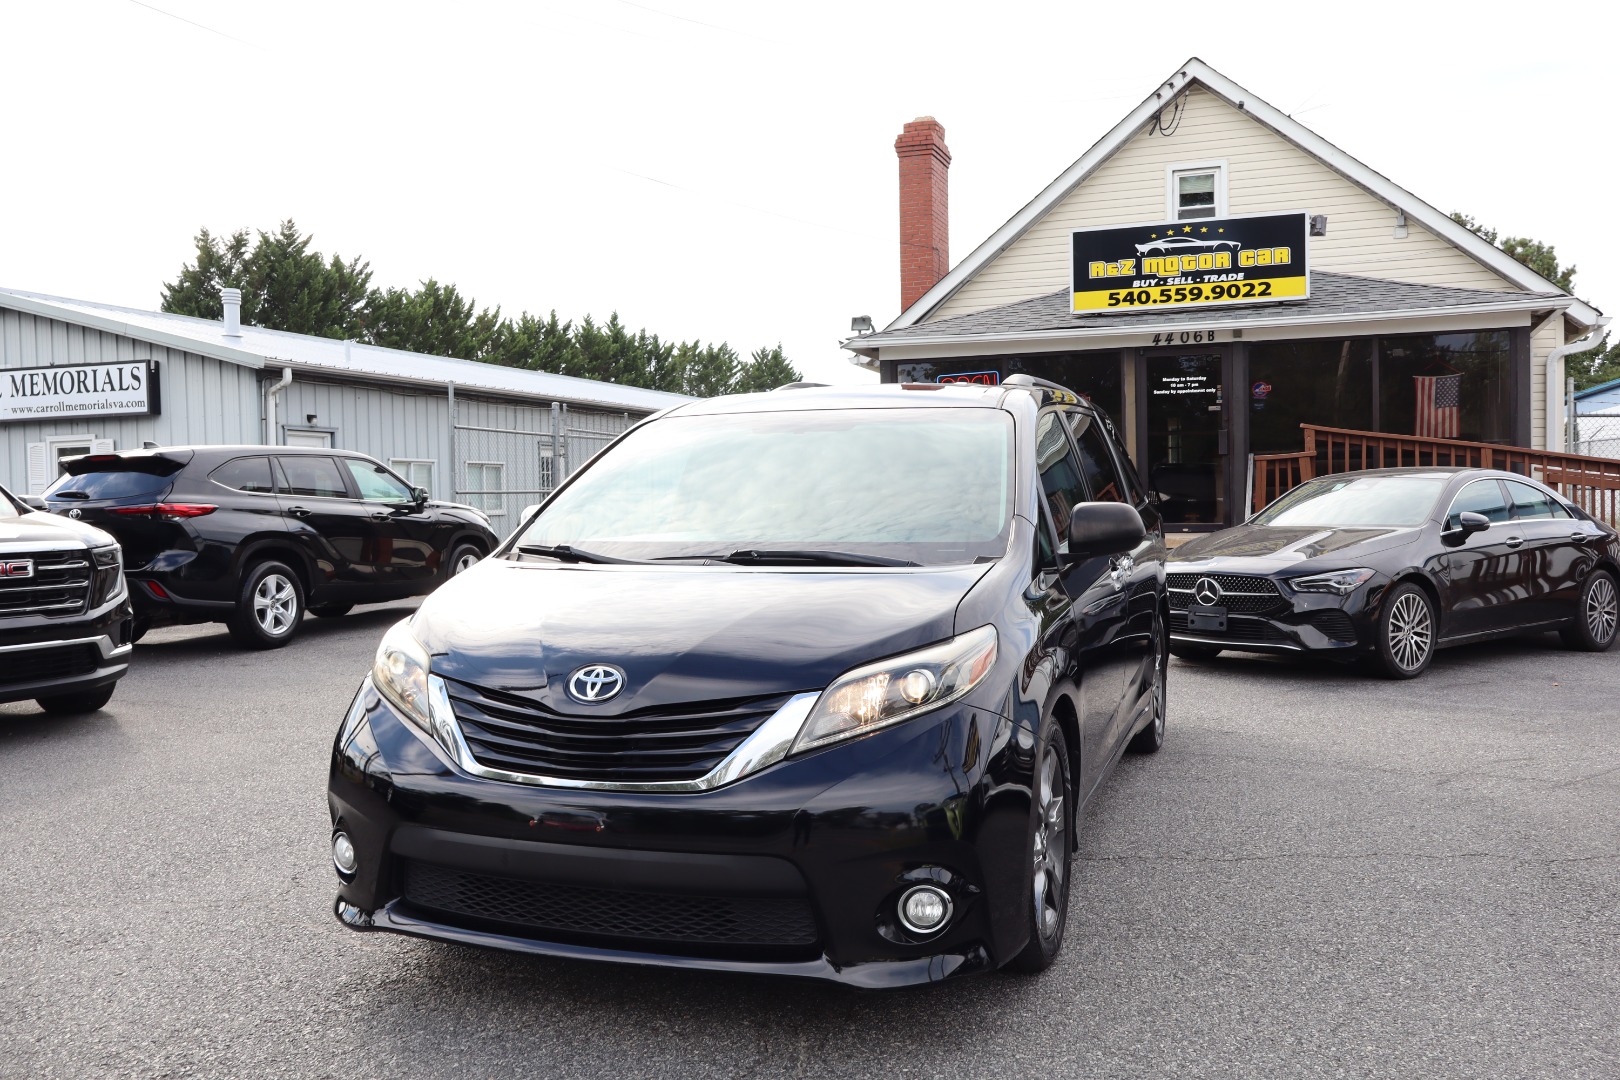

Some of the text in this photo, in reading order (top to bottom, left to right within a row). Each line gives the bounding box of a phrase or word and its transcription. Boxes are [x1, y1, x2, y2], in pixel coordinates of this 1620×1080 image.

[1132, 272, 1245, 288] BUY SELL TRADE
[1107, 281, 1272, 307] 540.559.9022
[10, 366, 142, 398] MEMORIALS
[11, 398, 146, 414] www.carrollmemorialsva.com
